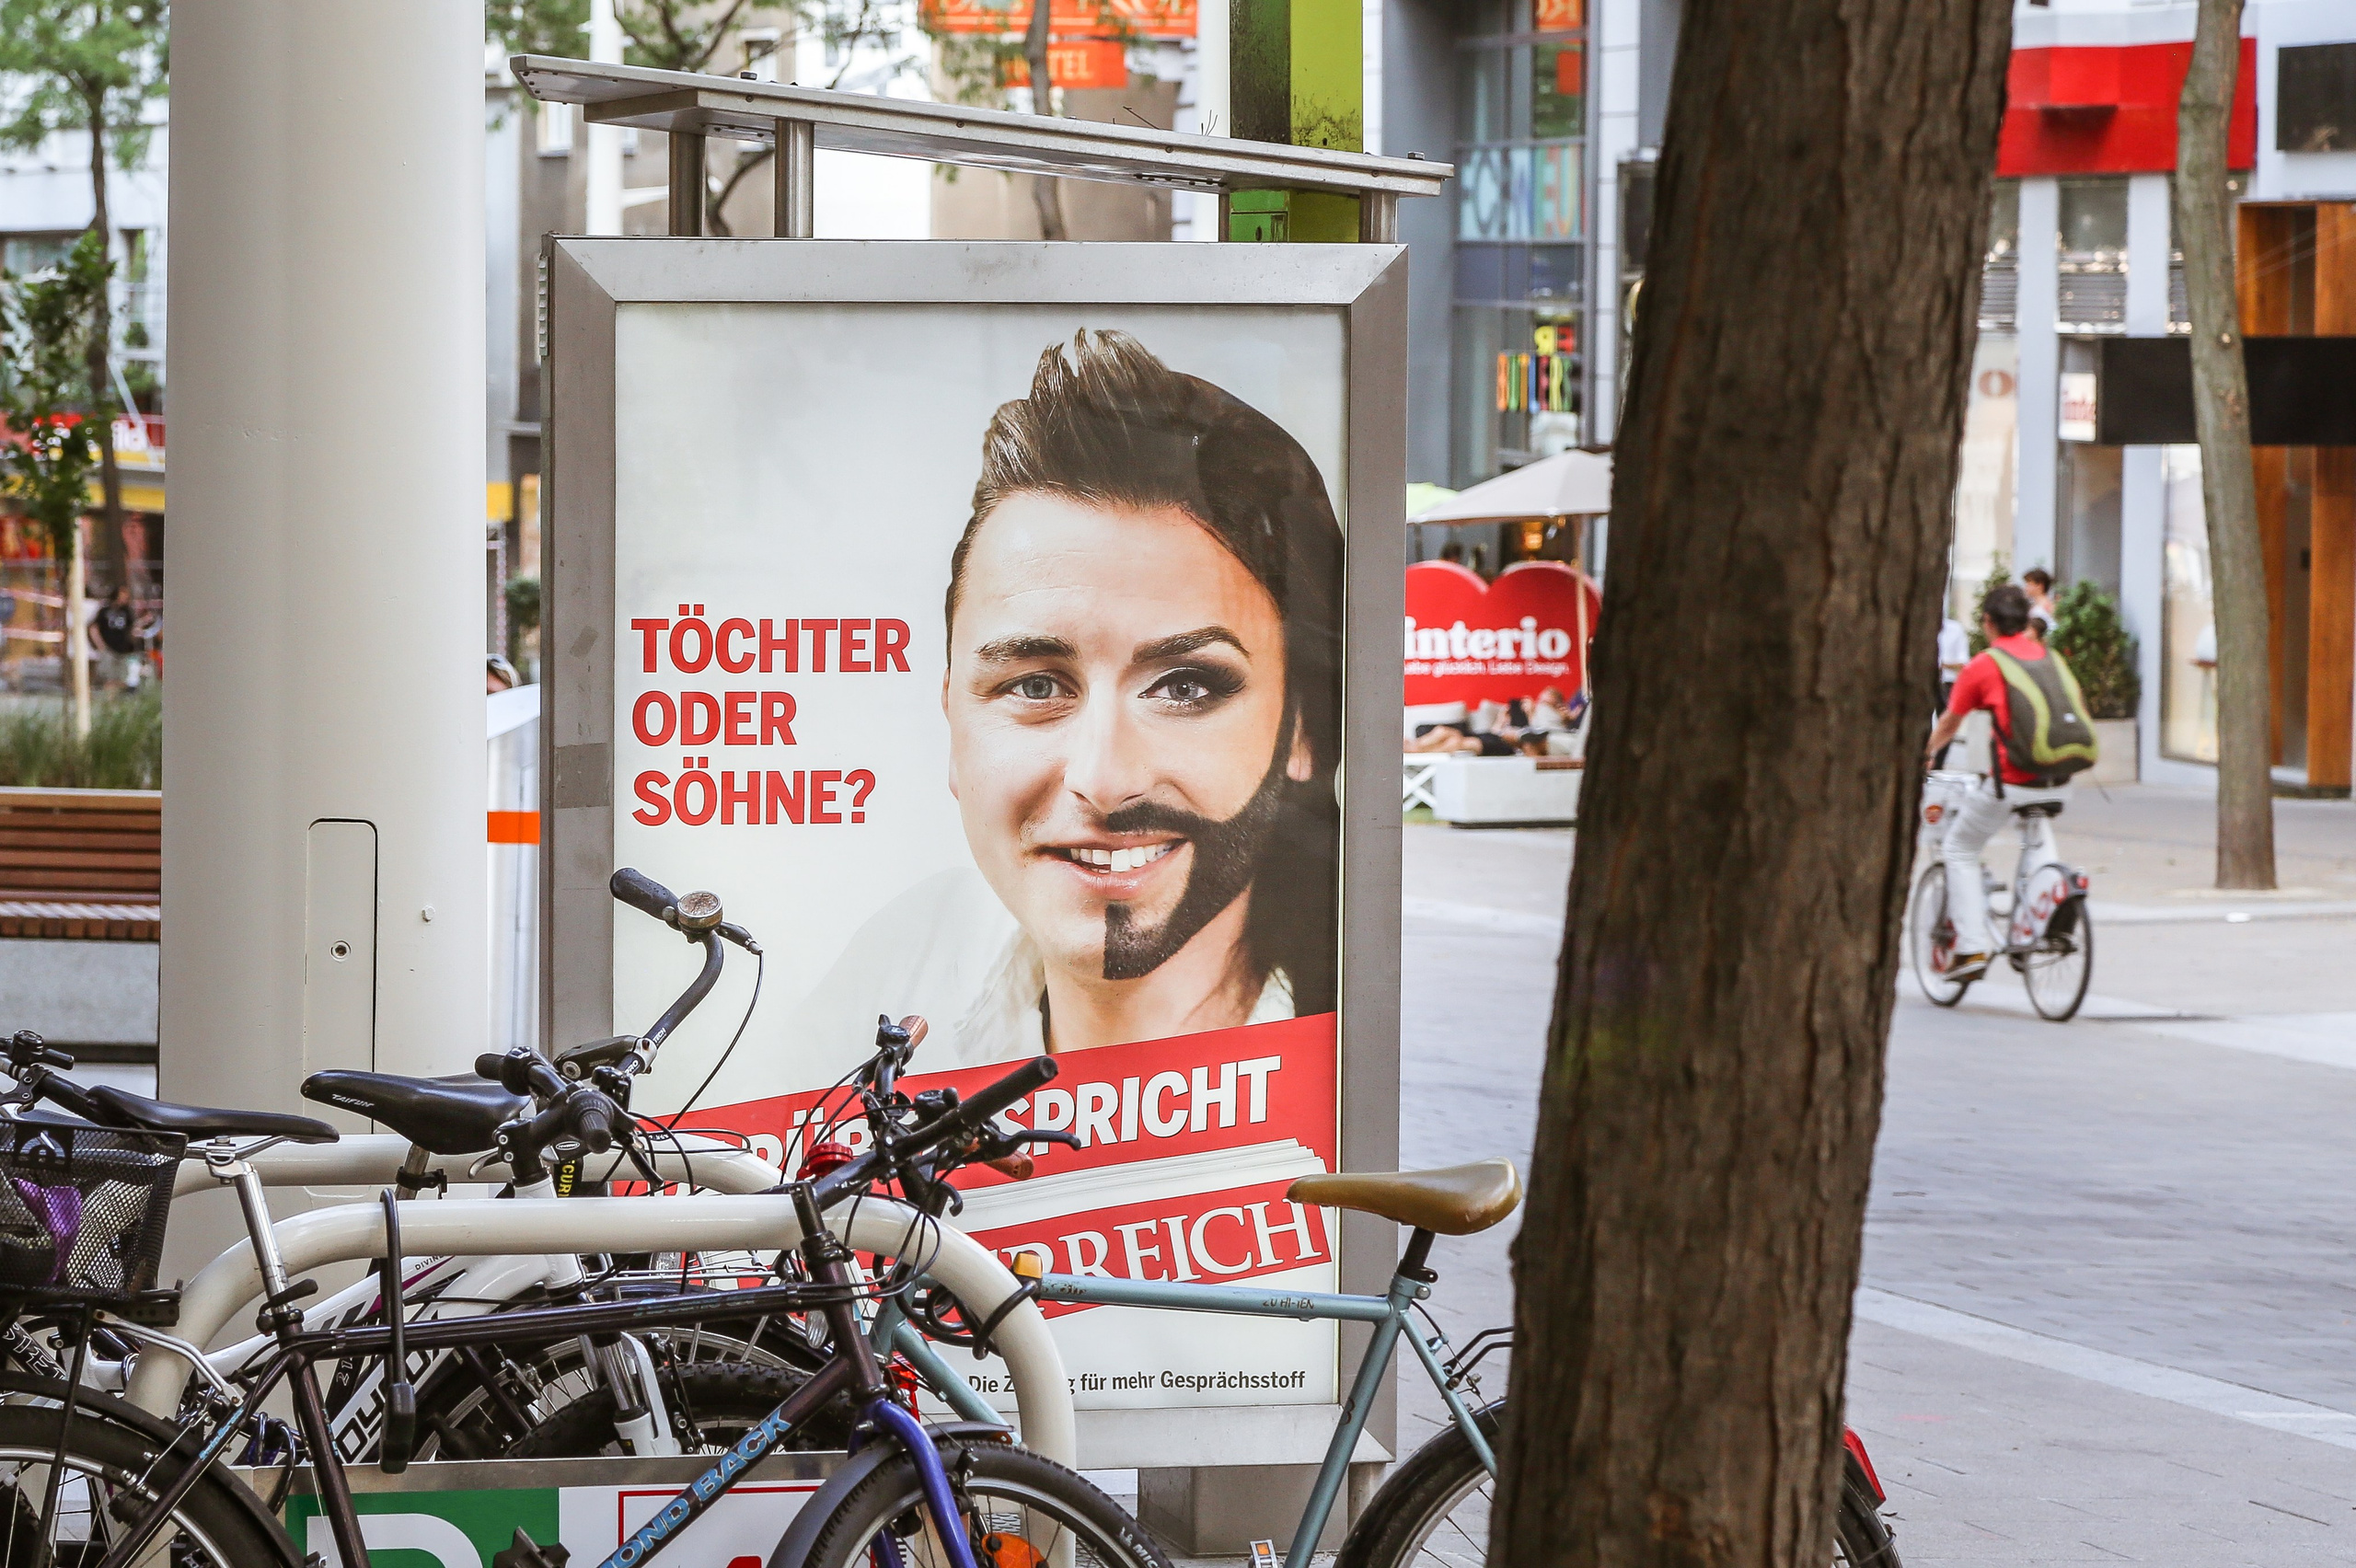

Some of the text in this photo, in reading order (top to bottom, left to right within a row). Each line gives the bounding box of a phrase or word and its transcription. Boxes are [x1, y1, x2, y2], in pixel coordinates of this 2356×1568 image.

[630, 604, 911, 674] TÖCHTER
[1404, 616, 1571, 660] interio
[631, 690, 798, 746] ODER
[631, 756, 876, 826] SÖHNE?
[332, 1093, 375, 1108] TAIFUN
[969, 1375, 999, 1393] Die
[1080, 1373, 1107, 1392] für
[1112, 1371, 1156, 1390] mehr
[1160, 1370, 1307, 1393] Gesprächsstoff
[598, 1409, 792, 1568] OND BACK
